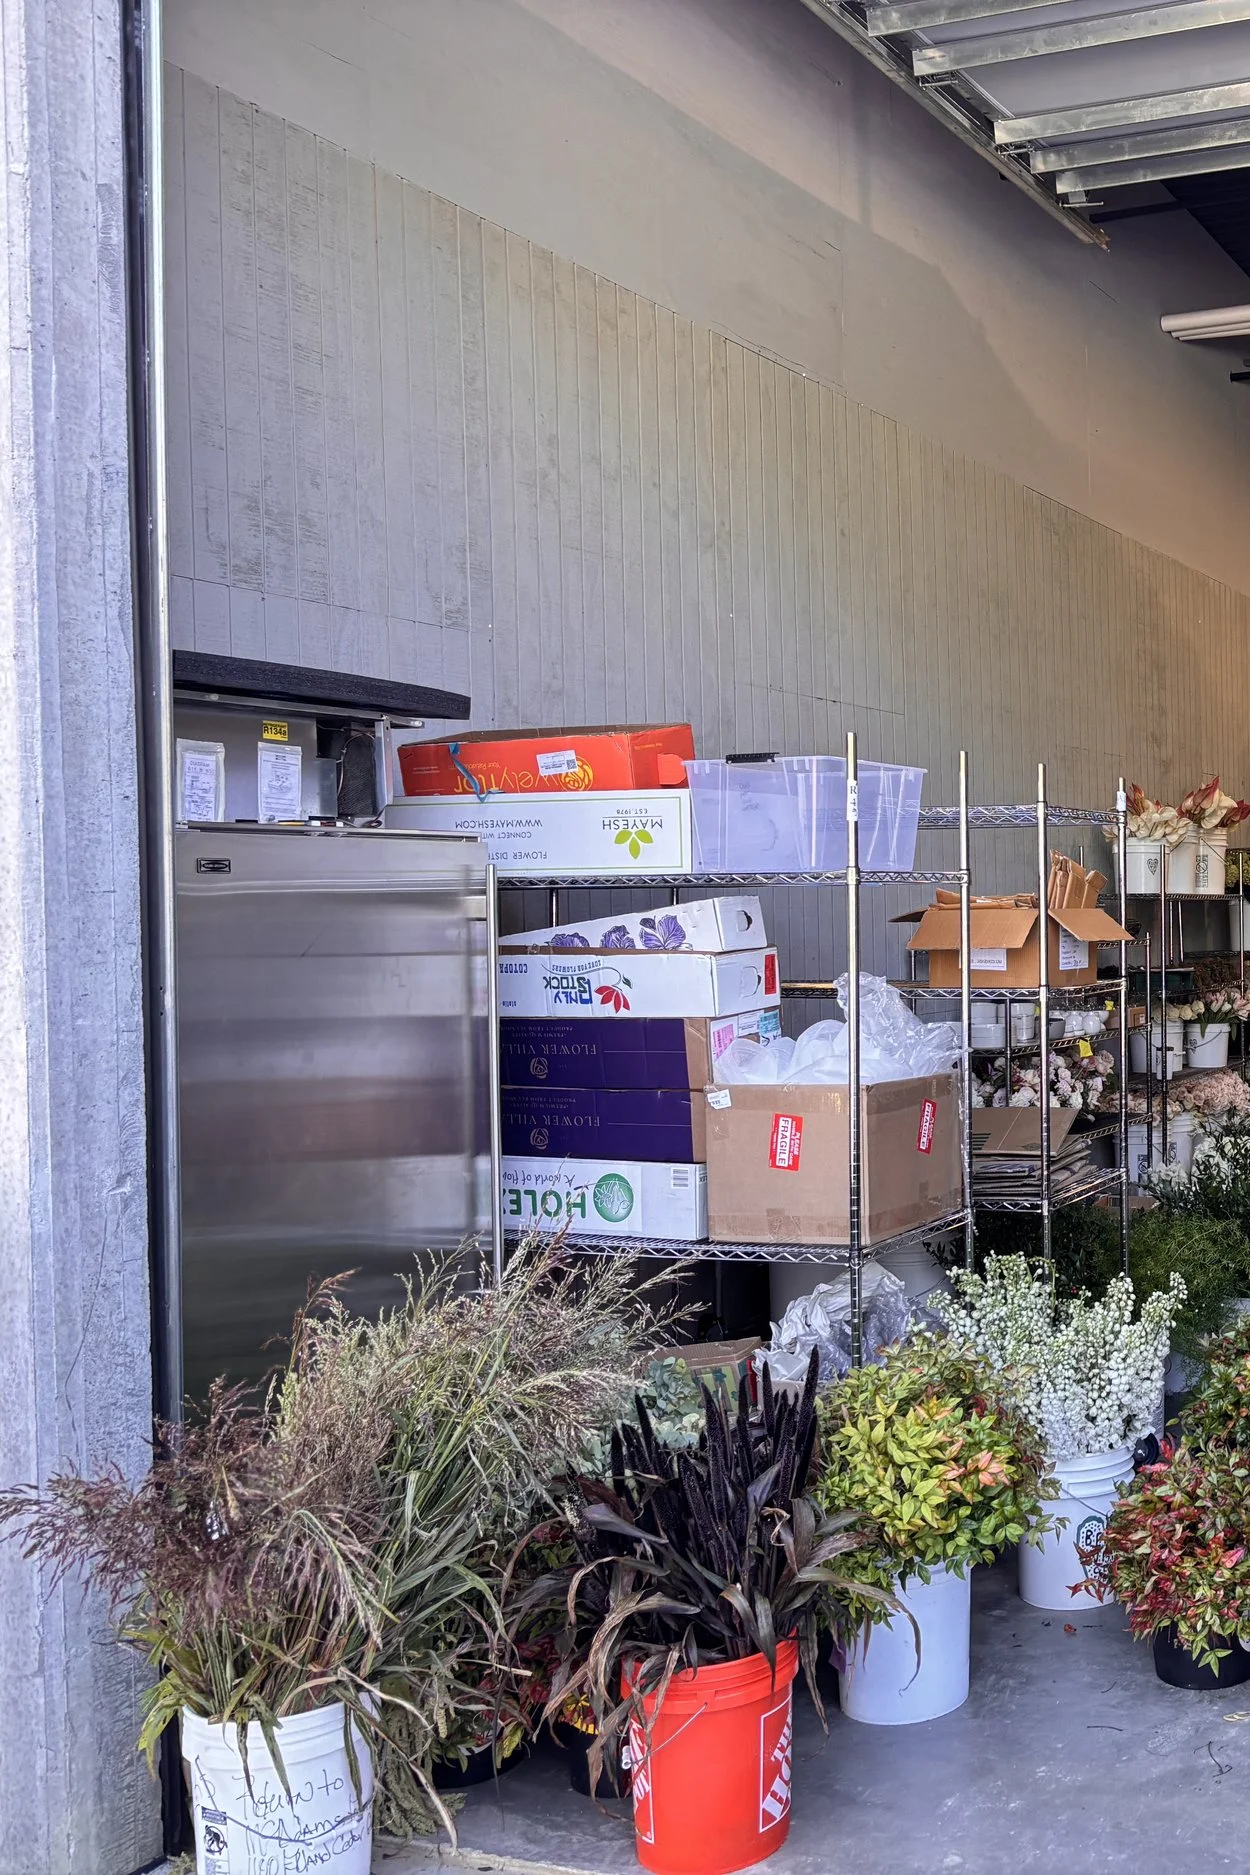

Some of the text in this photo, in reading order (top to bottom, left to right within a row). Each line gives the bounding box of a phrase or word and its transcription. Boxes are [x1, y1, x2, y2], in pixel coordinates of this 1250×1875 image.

[263, 726, 287, 736] R134a
[455, 819, 543, 829] WWW.MAYESH.COM
[602, 818, 662, 830] MAYESH
[481, 831, 532, 840] CONNECT WIT
[513, 851, 548, 860] FLOWER
[543, 976, 587, 994] STOCK
[501, 1043, 597, 1055] FLOWER VILL
[502, 1113, 600, 1126] FLOWER VILL
[778, 1119, 790, 1165] FRAGILE
[502, 1188, 587, 1219] HOLE
[318, 1769, 344, 1796] to
